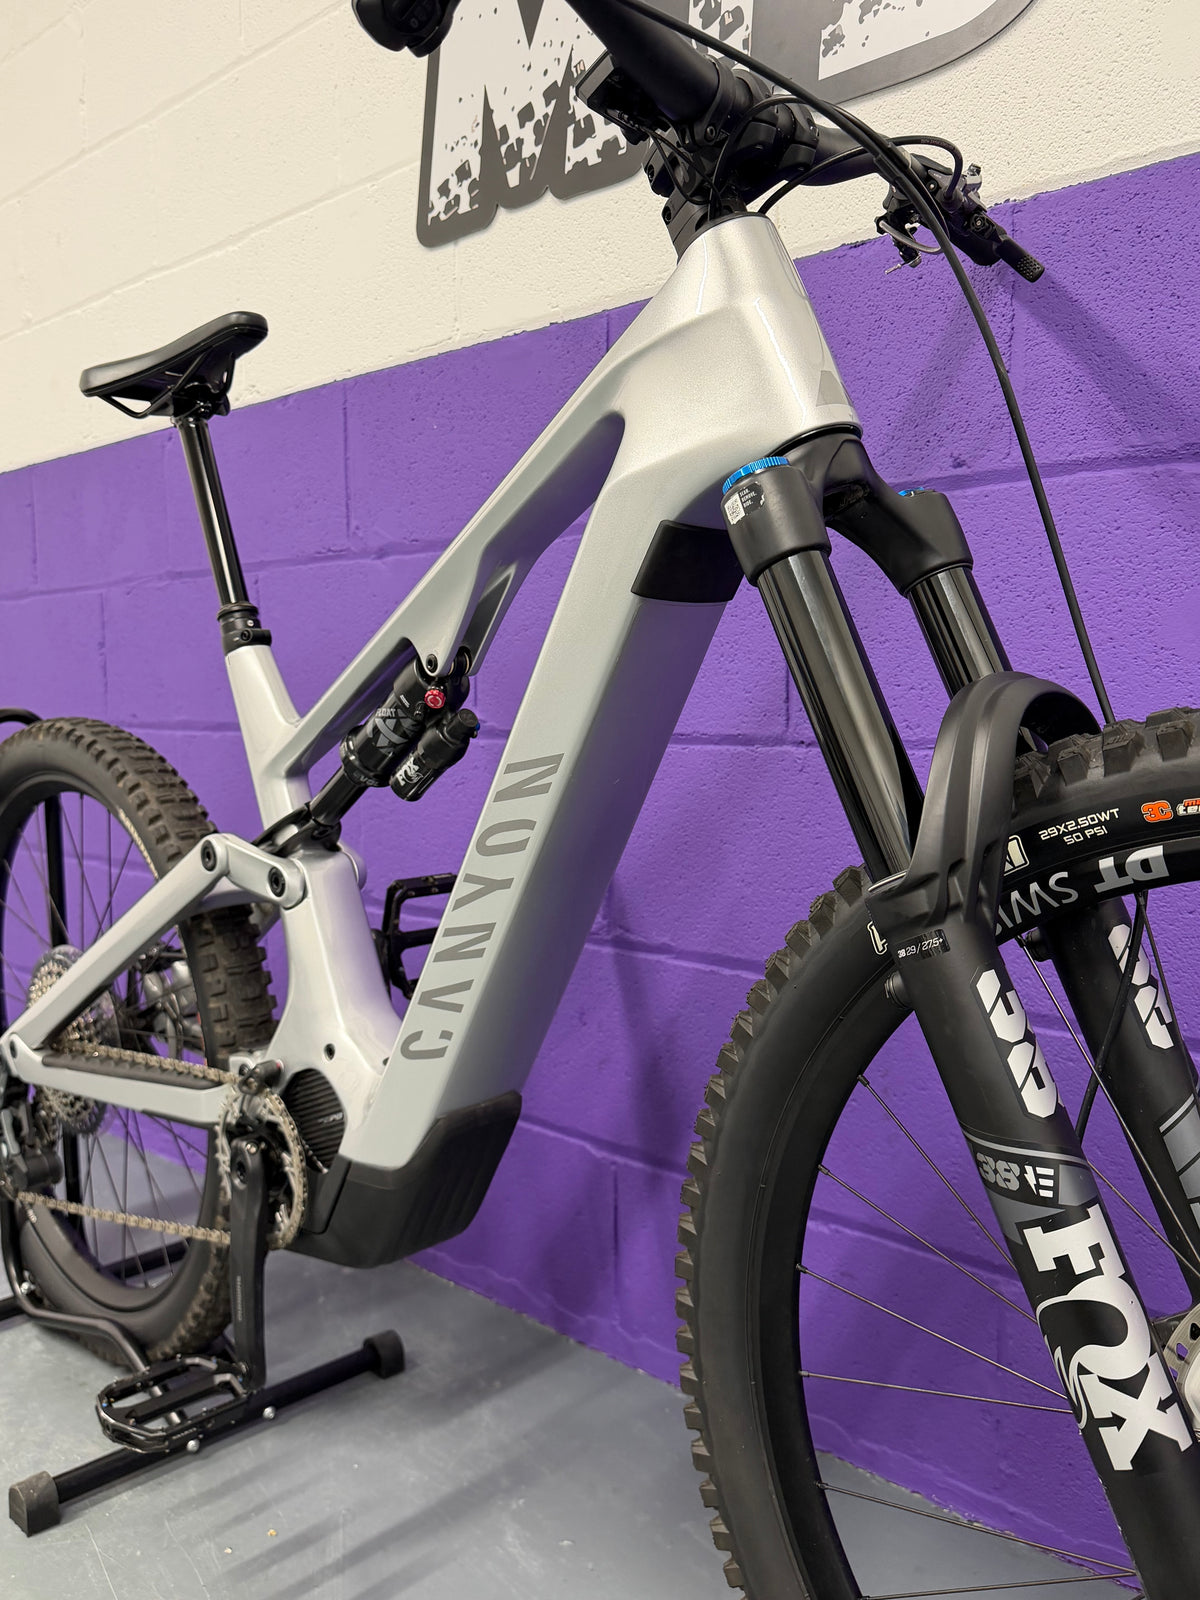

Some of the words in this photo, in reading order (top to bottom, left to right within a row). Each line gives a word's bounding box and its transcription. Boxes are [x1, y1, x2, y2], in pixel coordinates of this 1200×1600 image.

[396, 756, 423, 786] FOX
[1038, 808, 1120, 841] 29X2.50WT
[1141, 800, 1173, 822] 3C
[1062, 832, 1084, 845] 50
[1086, 825, 1108, 839] PSI
[1093, 845, 1170, 893] DT
[400, 753, 565, 1060] CANYON
[995, 871, 1079, 936] SWI
[905, 945, 917, 956] 29
[976, 1152, 1021, 1192] 38
[1022, 1203, 1194, 1471] FOX
